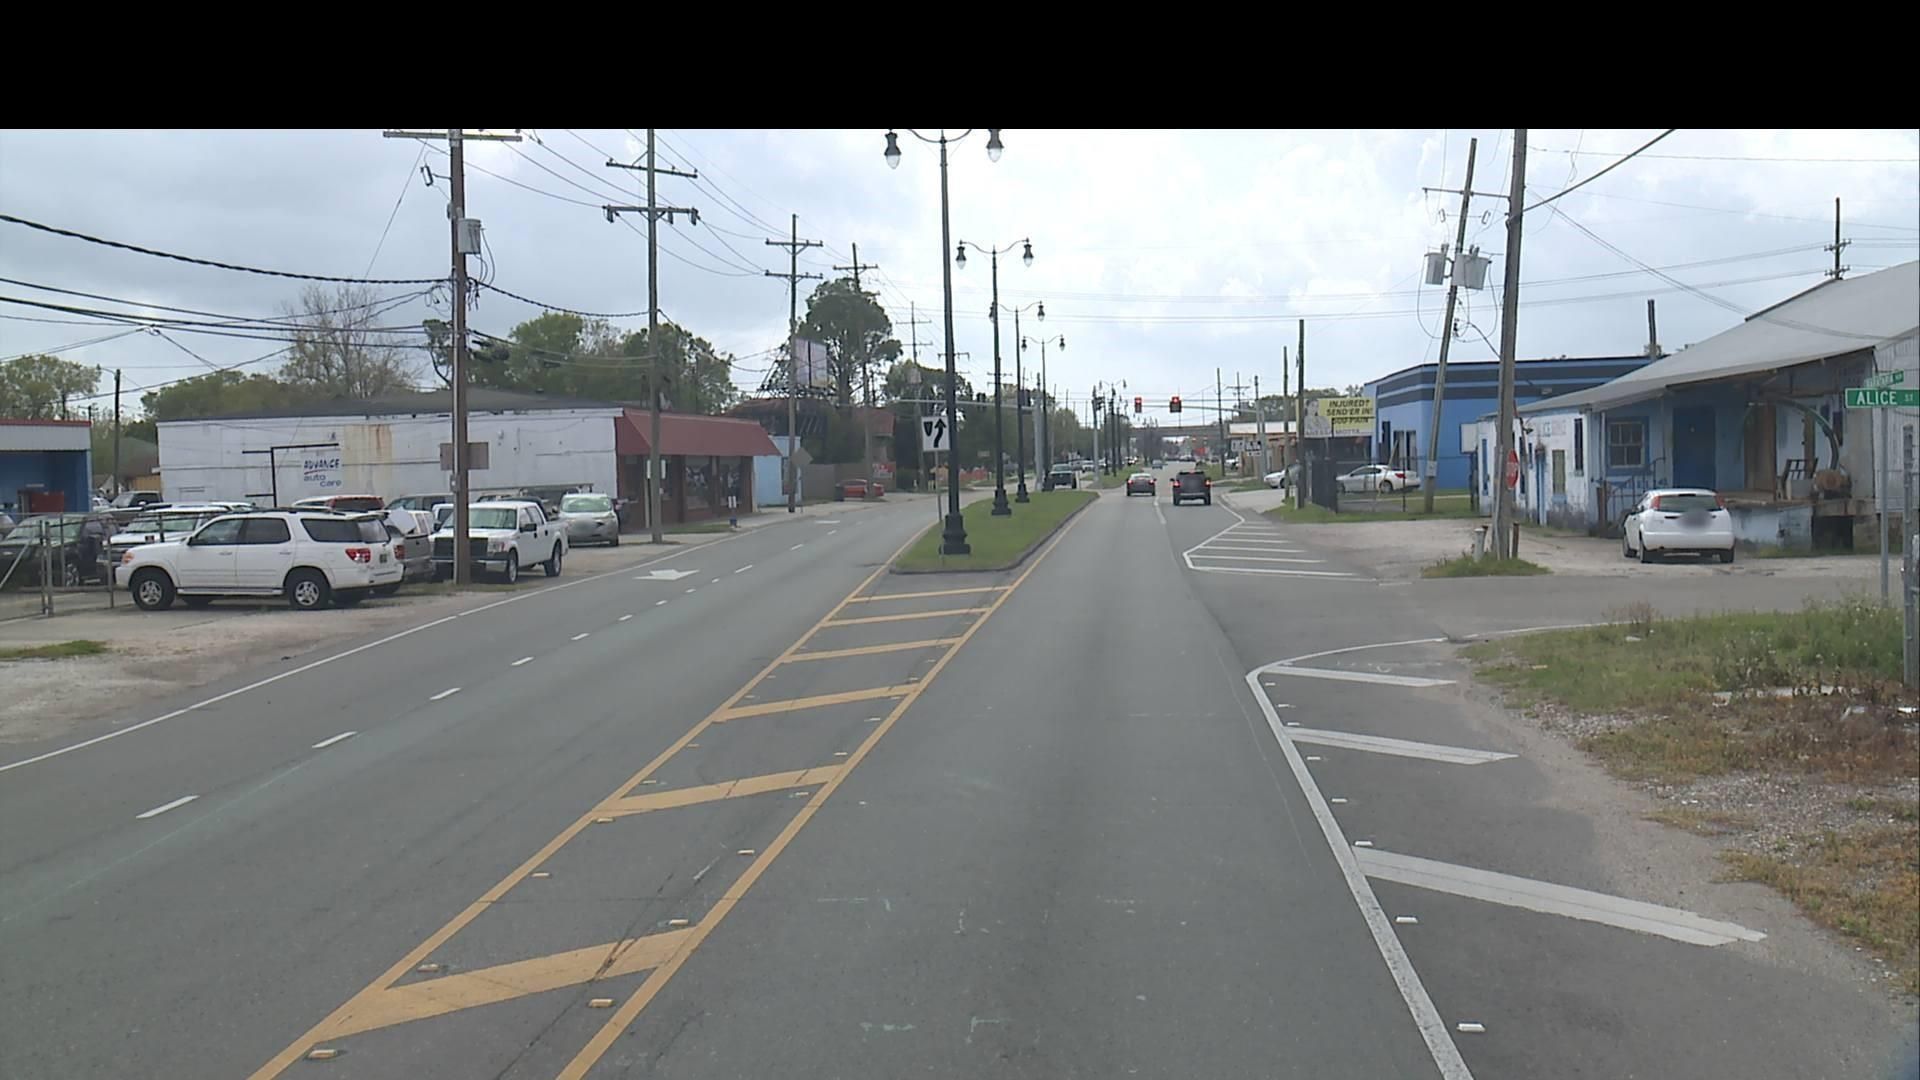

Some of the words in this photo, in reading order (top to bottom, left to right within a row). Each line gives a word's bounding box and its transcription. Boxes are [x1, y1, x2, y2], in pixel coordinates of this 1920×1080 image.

[1857, 391, 1897, 405] ALICE
[1329, 400, 1370, 408] INJURED?
[304, 458, 340, 469] ADVANCE
